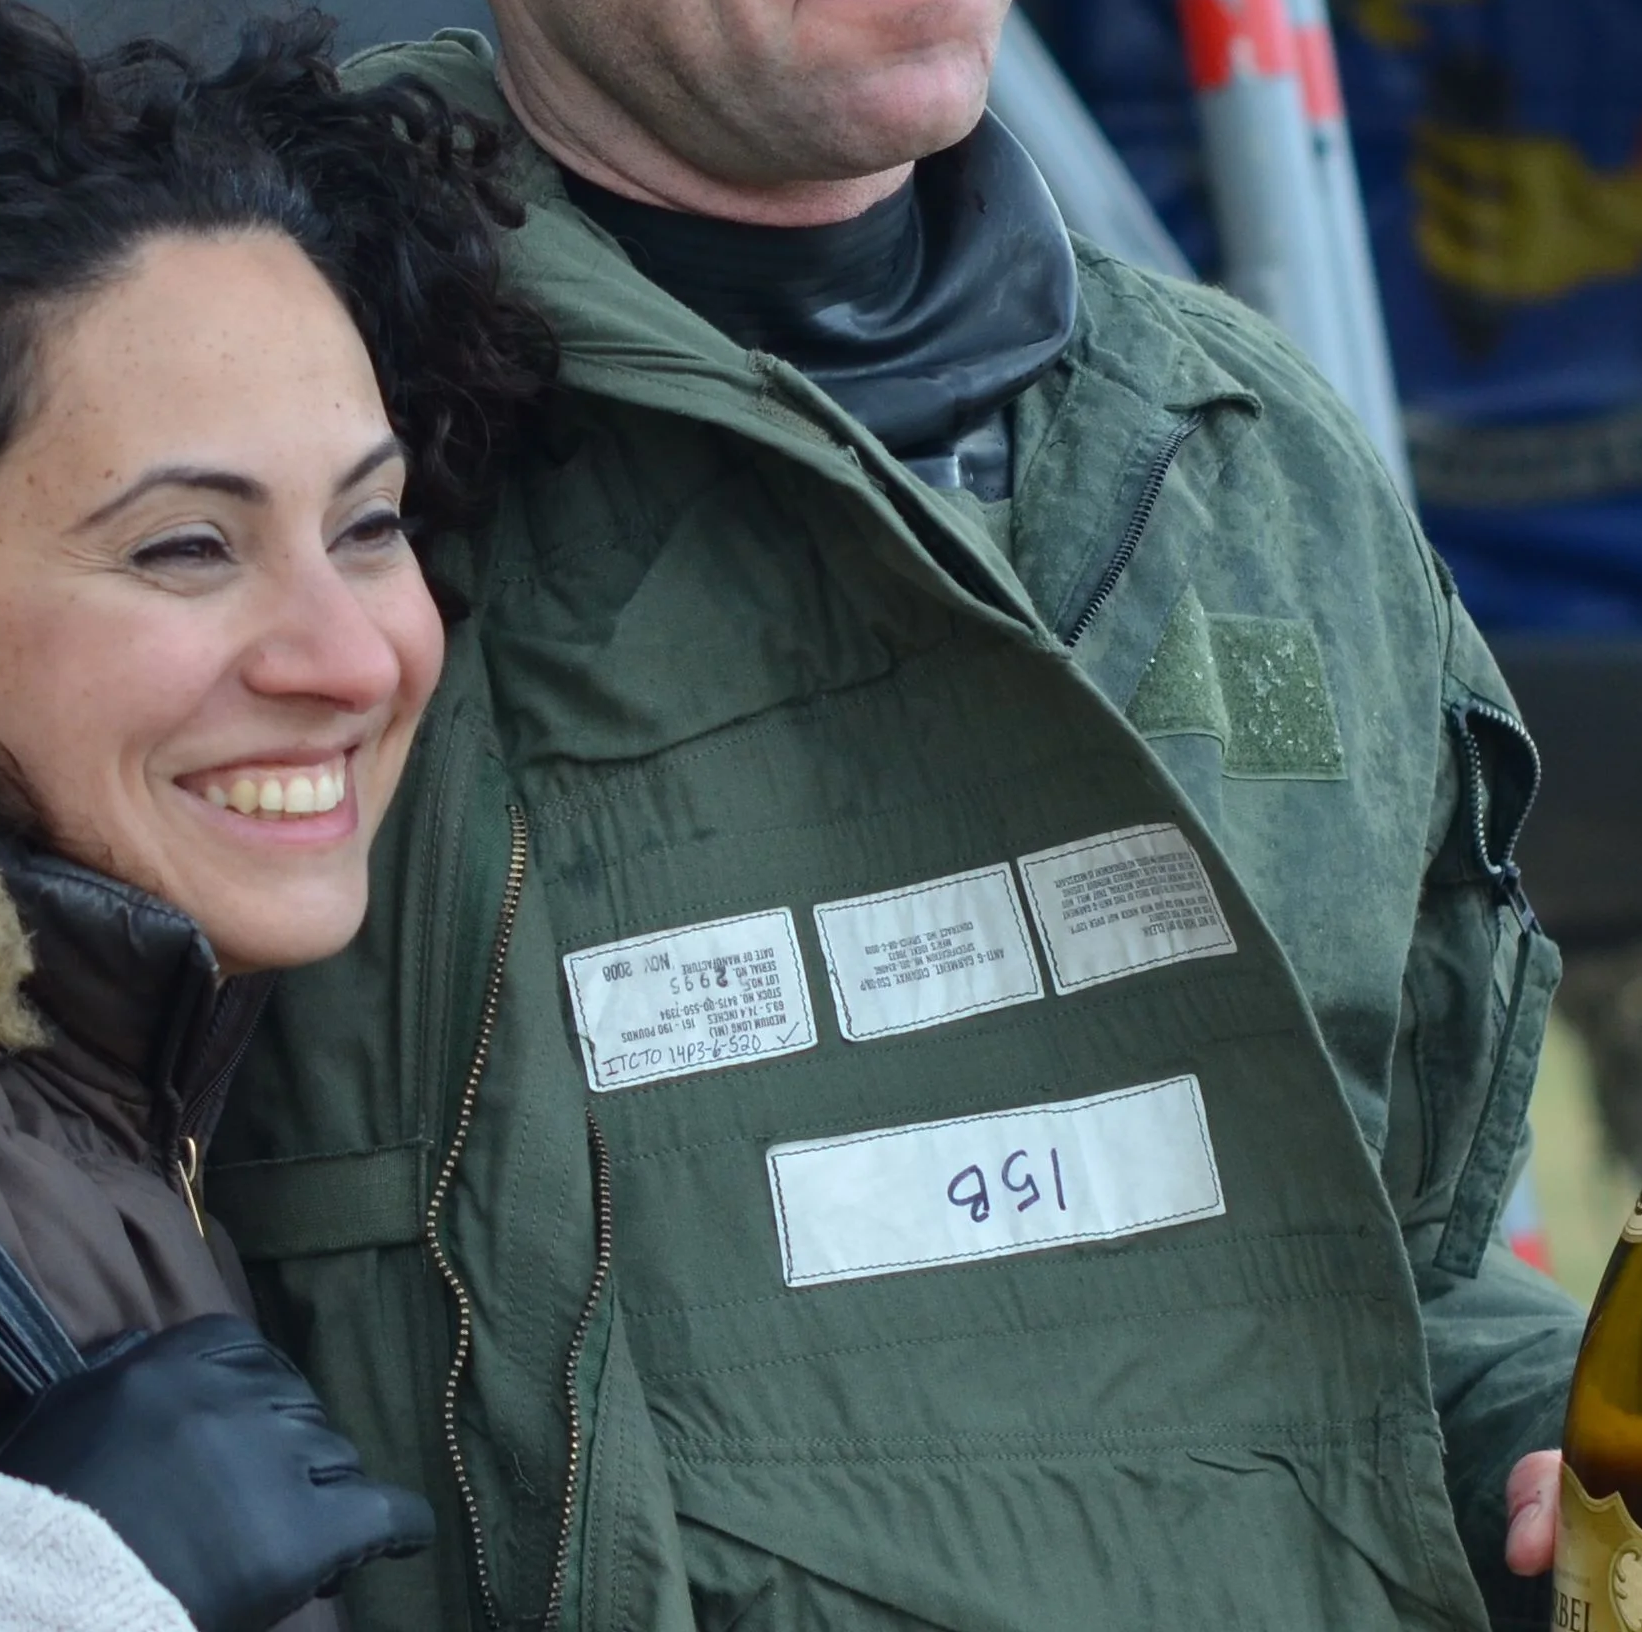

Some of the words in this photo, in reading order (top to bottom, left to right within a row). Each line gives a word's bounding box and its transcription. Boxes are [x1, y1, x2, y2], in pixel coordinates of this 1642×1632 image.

[743, 952, 753, 963] OF
[754, 948, 774, 961] DATE
[977, 949, 1004, 964] ANTI-G
[645, 952, 670, 973] NOV
[681, 955, 741, 975] MANUFACTURE
[749, 960, 777, 974] SERIAL
[602, 961, 632, 982] 2008
[733, 967, 748, 978] NO.
[765, 974, 779, 986] LOT
[739, 993, 755, 1004] NO.
[756, 987, 781, 1001] STOCK
[740, 1006, 758, 1018] 74.4
[765, 1000, 784, 1013] 69.5
[707, 1009, 738, 1024] INCHES
[754, 1014, 786, 1029] MEDIUM
[658, 1023, 673, 1035] 190
[682, 1018, 695, 1030] 161
[709, 1024, 728, 1038] (ML)
[731, 1020, 752, 1033] LONG
[621, 1026, 656, 1043] POUNDS
[947, 1148, 1066, 1223] 15B
